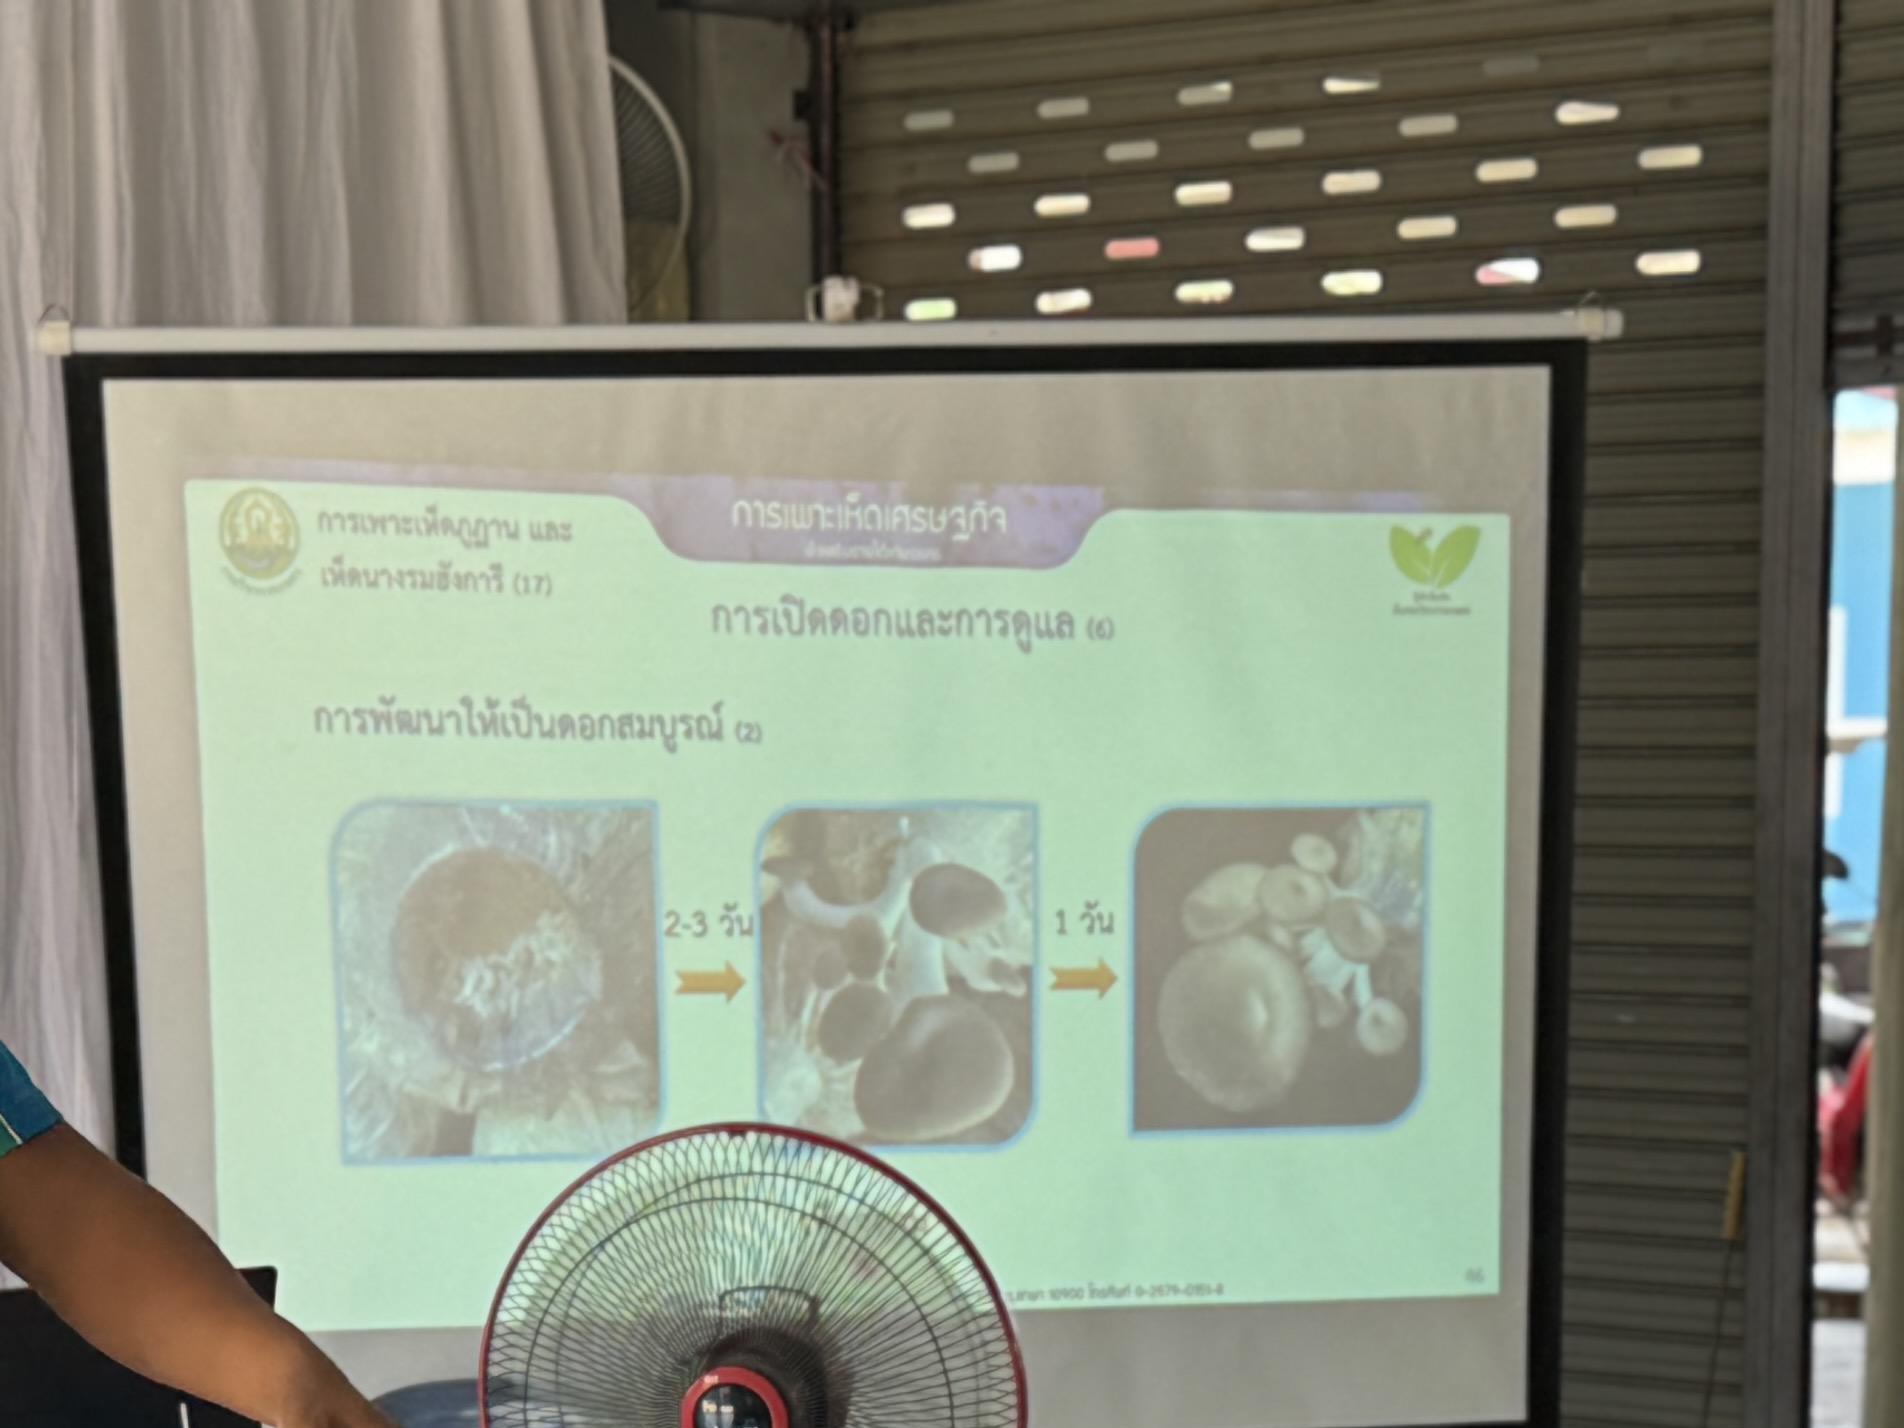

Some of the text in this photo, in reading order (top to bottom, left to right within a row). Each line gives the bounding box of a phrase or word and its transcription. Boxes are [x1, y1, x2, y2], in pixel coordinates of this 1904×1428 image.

[528, 518, 574, 543] และ
[731, 489, 1008, 543] การเพาะเห็ดเศรษฐกิจ
[511, 571, 554, 598] (17)
[711, 593, 1076, 654] การเปิดดอกและการดูแล
[313, 694, 764, 755] การพัฒนาให้เป็นดอกสมบูรณ์ (2)
[664, 901, 754, 938] 2-3 วัน
[1053, 900, 1116, 937] 1 วัน
